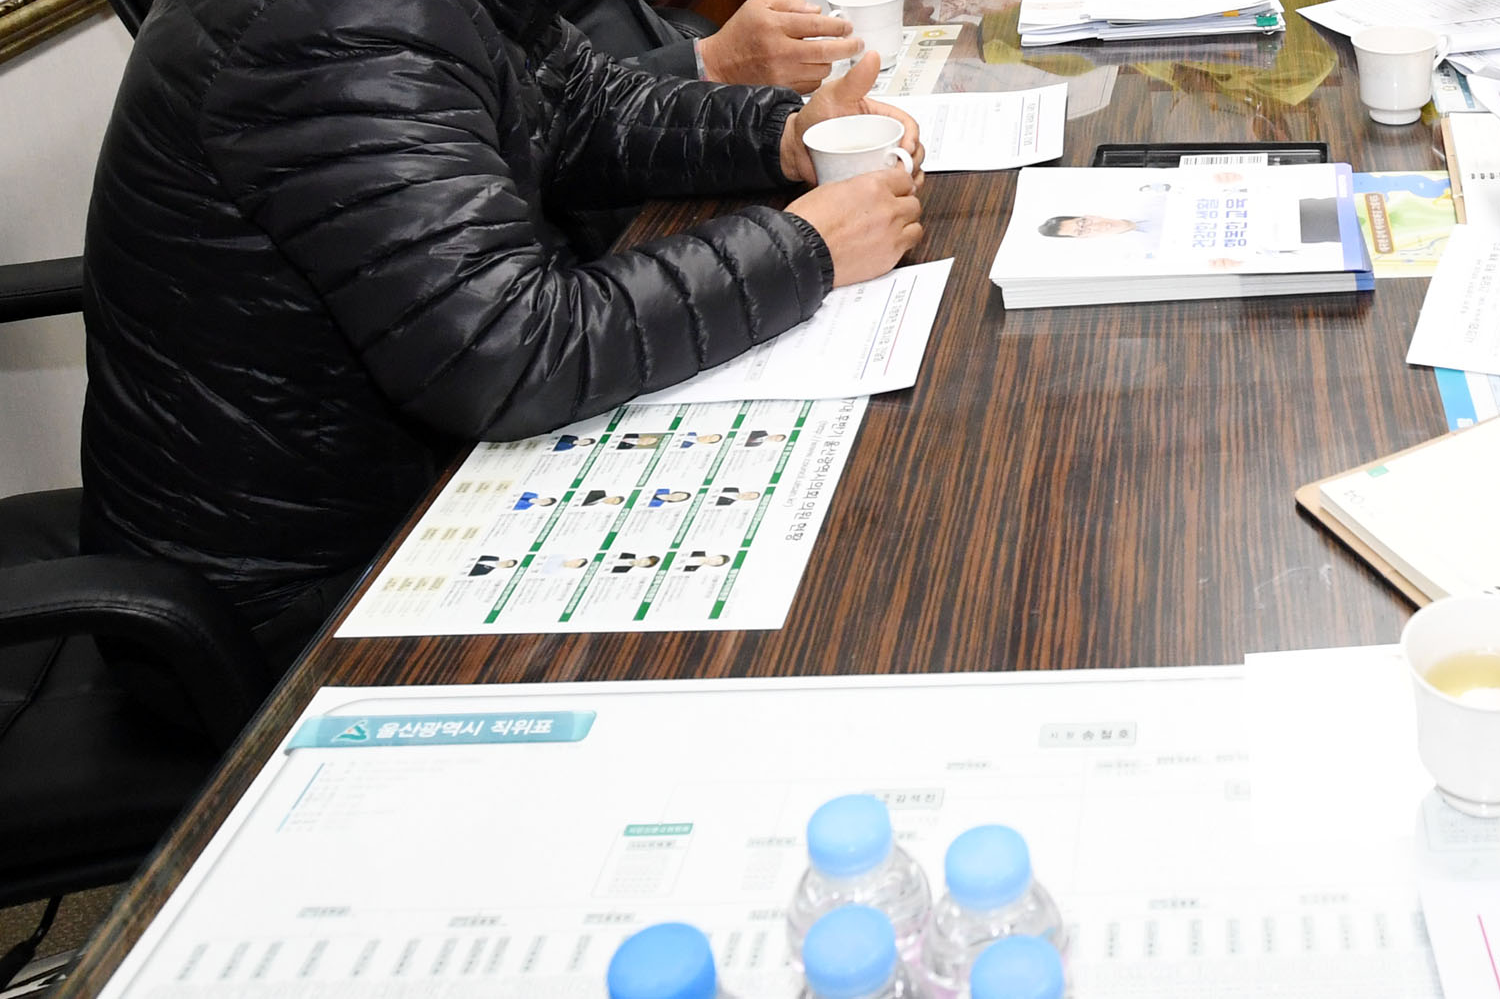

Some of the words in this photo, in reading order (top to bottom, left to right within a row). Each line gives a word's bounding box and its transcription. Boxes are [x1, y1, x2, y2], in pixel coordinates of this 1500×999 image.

[802, 440, 840, 499] 울산광역시의회
[793, 501, 815, 519] 의원
[784, 522, 807, 541] 현황
[376, 718, 486, 740] 울산광역시
[490, 717, 553, 737] 직위표
